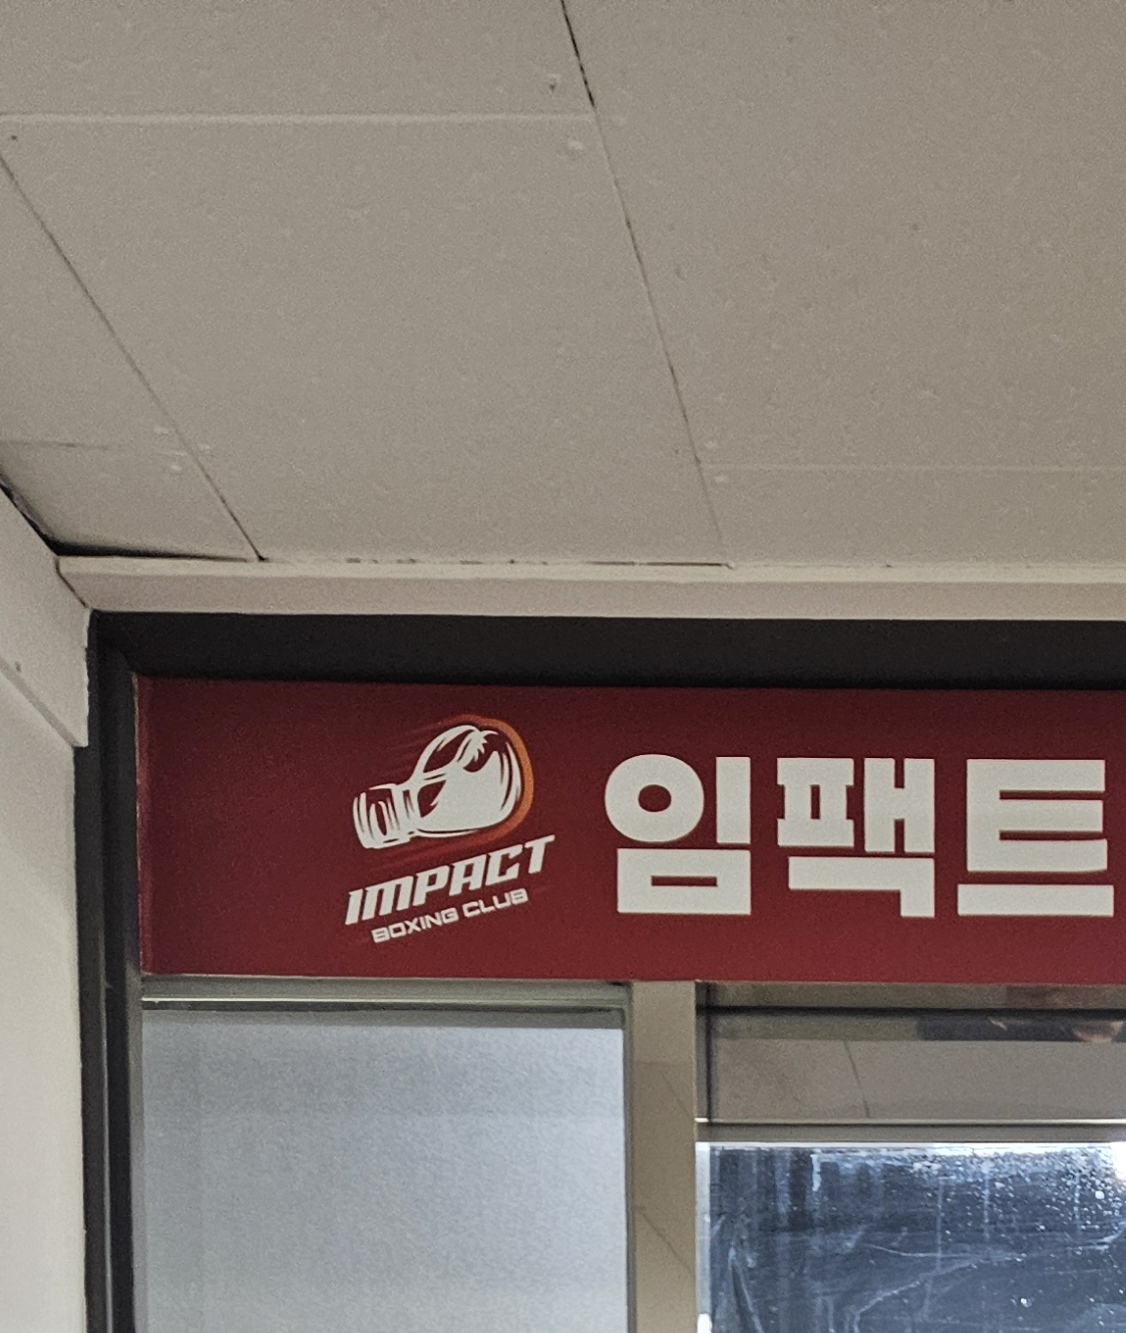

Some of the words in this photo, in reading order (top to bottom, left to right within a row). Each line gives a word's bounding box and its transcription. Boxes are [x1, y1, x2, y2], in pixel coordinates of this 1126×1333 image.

[345, 834, 555, 925] IMPACT
[604, 752, 1115, 919] 임팩트
[371, 907, 460, 943] BOXING
[463, 888, 529, 919] CLUB
